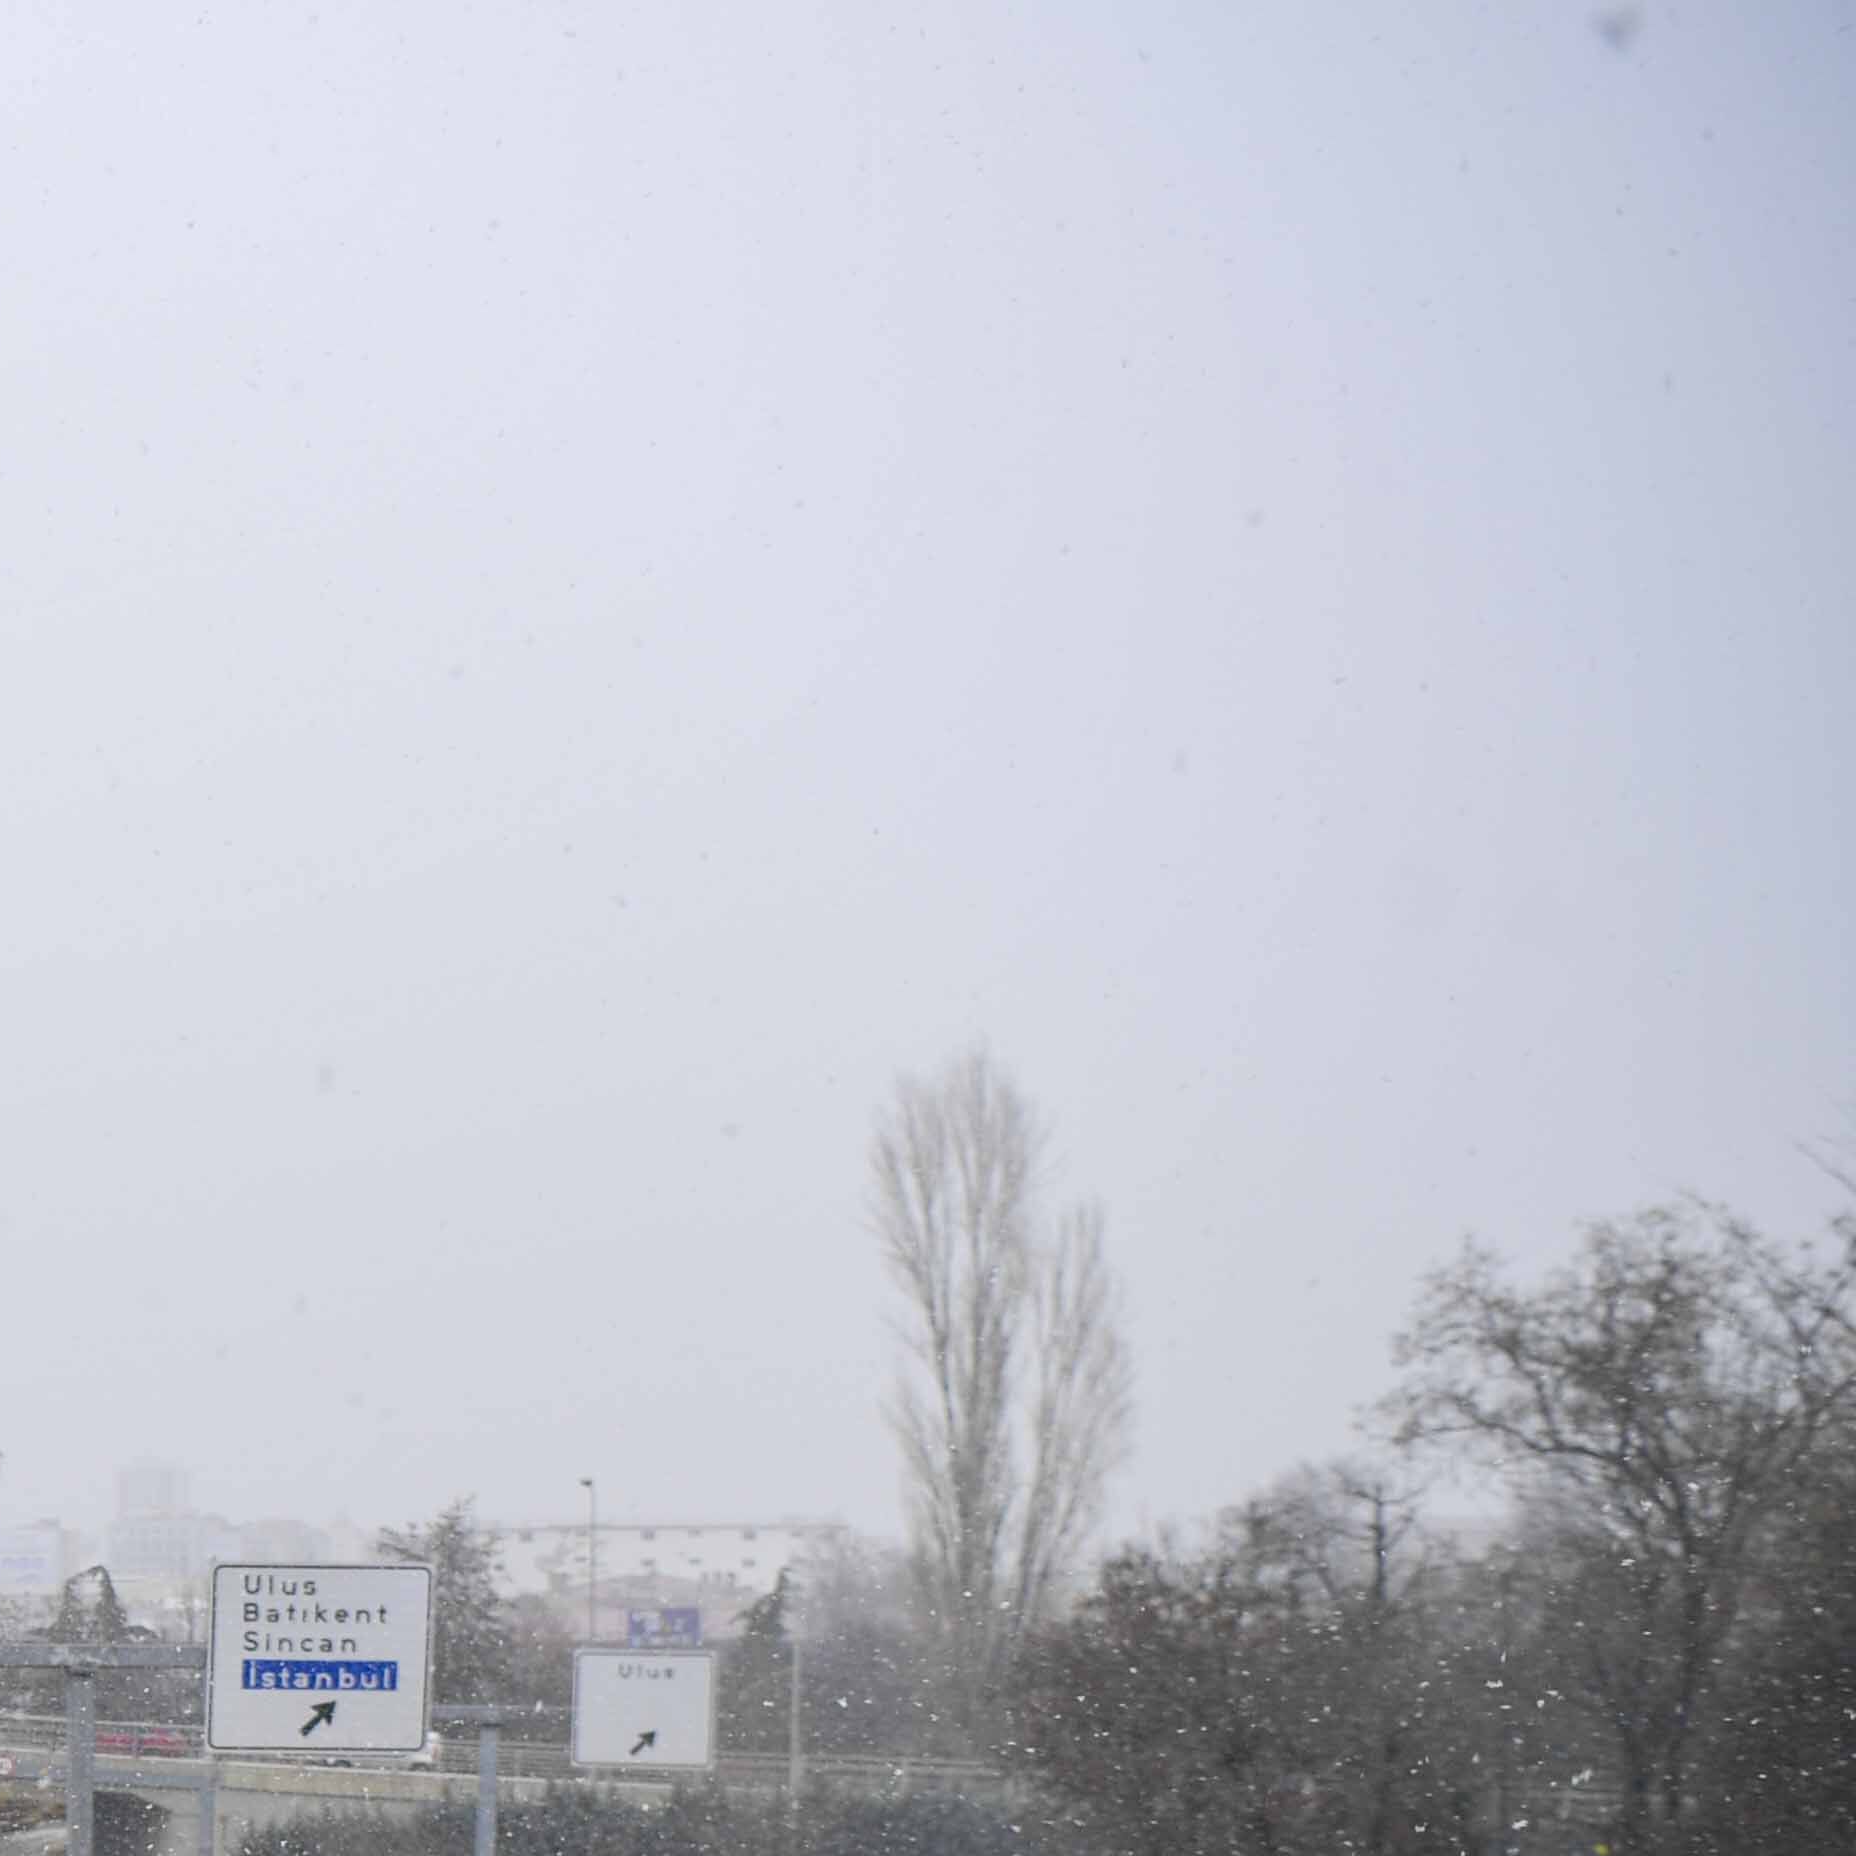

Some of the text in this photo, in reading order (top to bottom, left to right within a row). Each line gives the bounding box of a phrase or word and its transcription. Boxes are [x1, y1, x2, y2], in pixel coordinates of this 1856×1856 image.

[244, 1574, 317, 1596] Ulus
[243, 1602, 388, 1624] Batıkent
[243, 1631, 357, 1652] Sincan
[618, 1663, 676, 1680] Ulus
